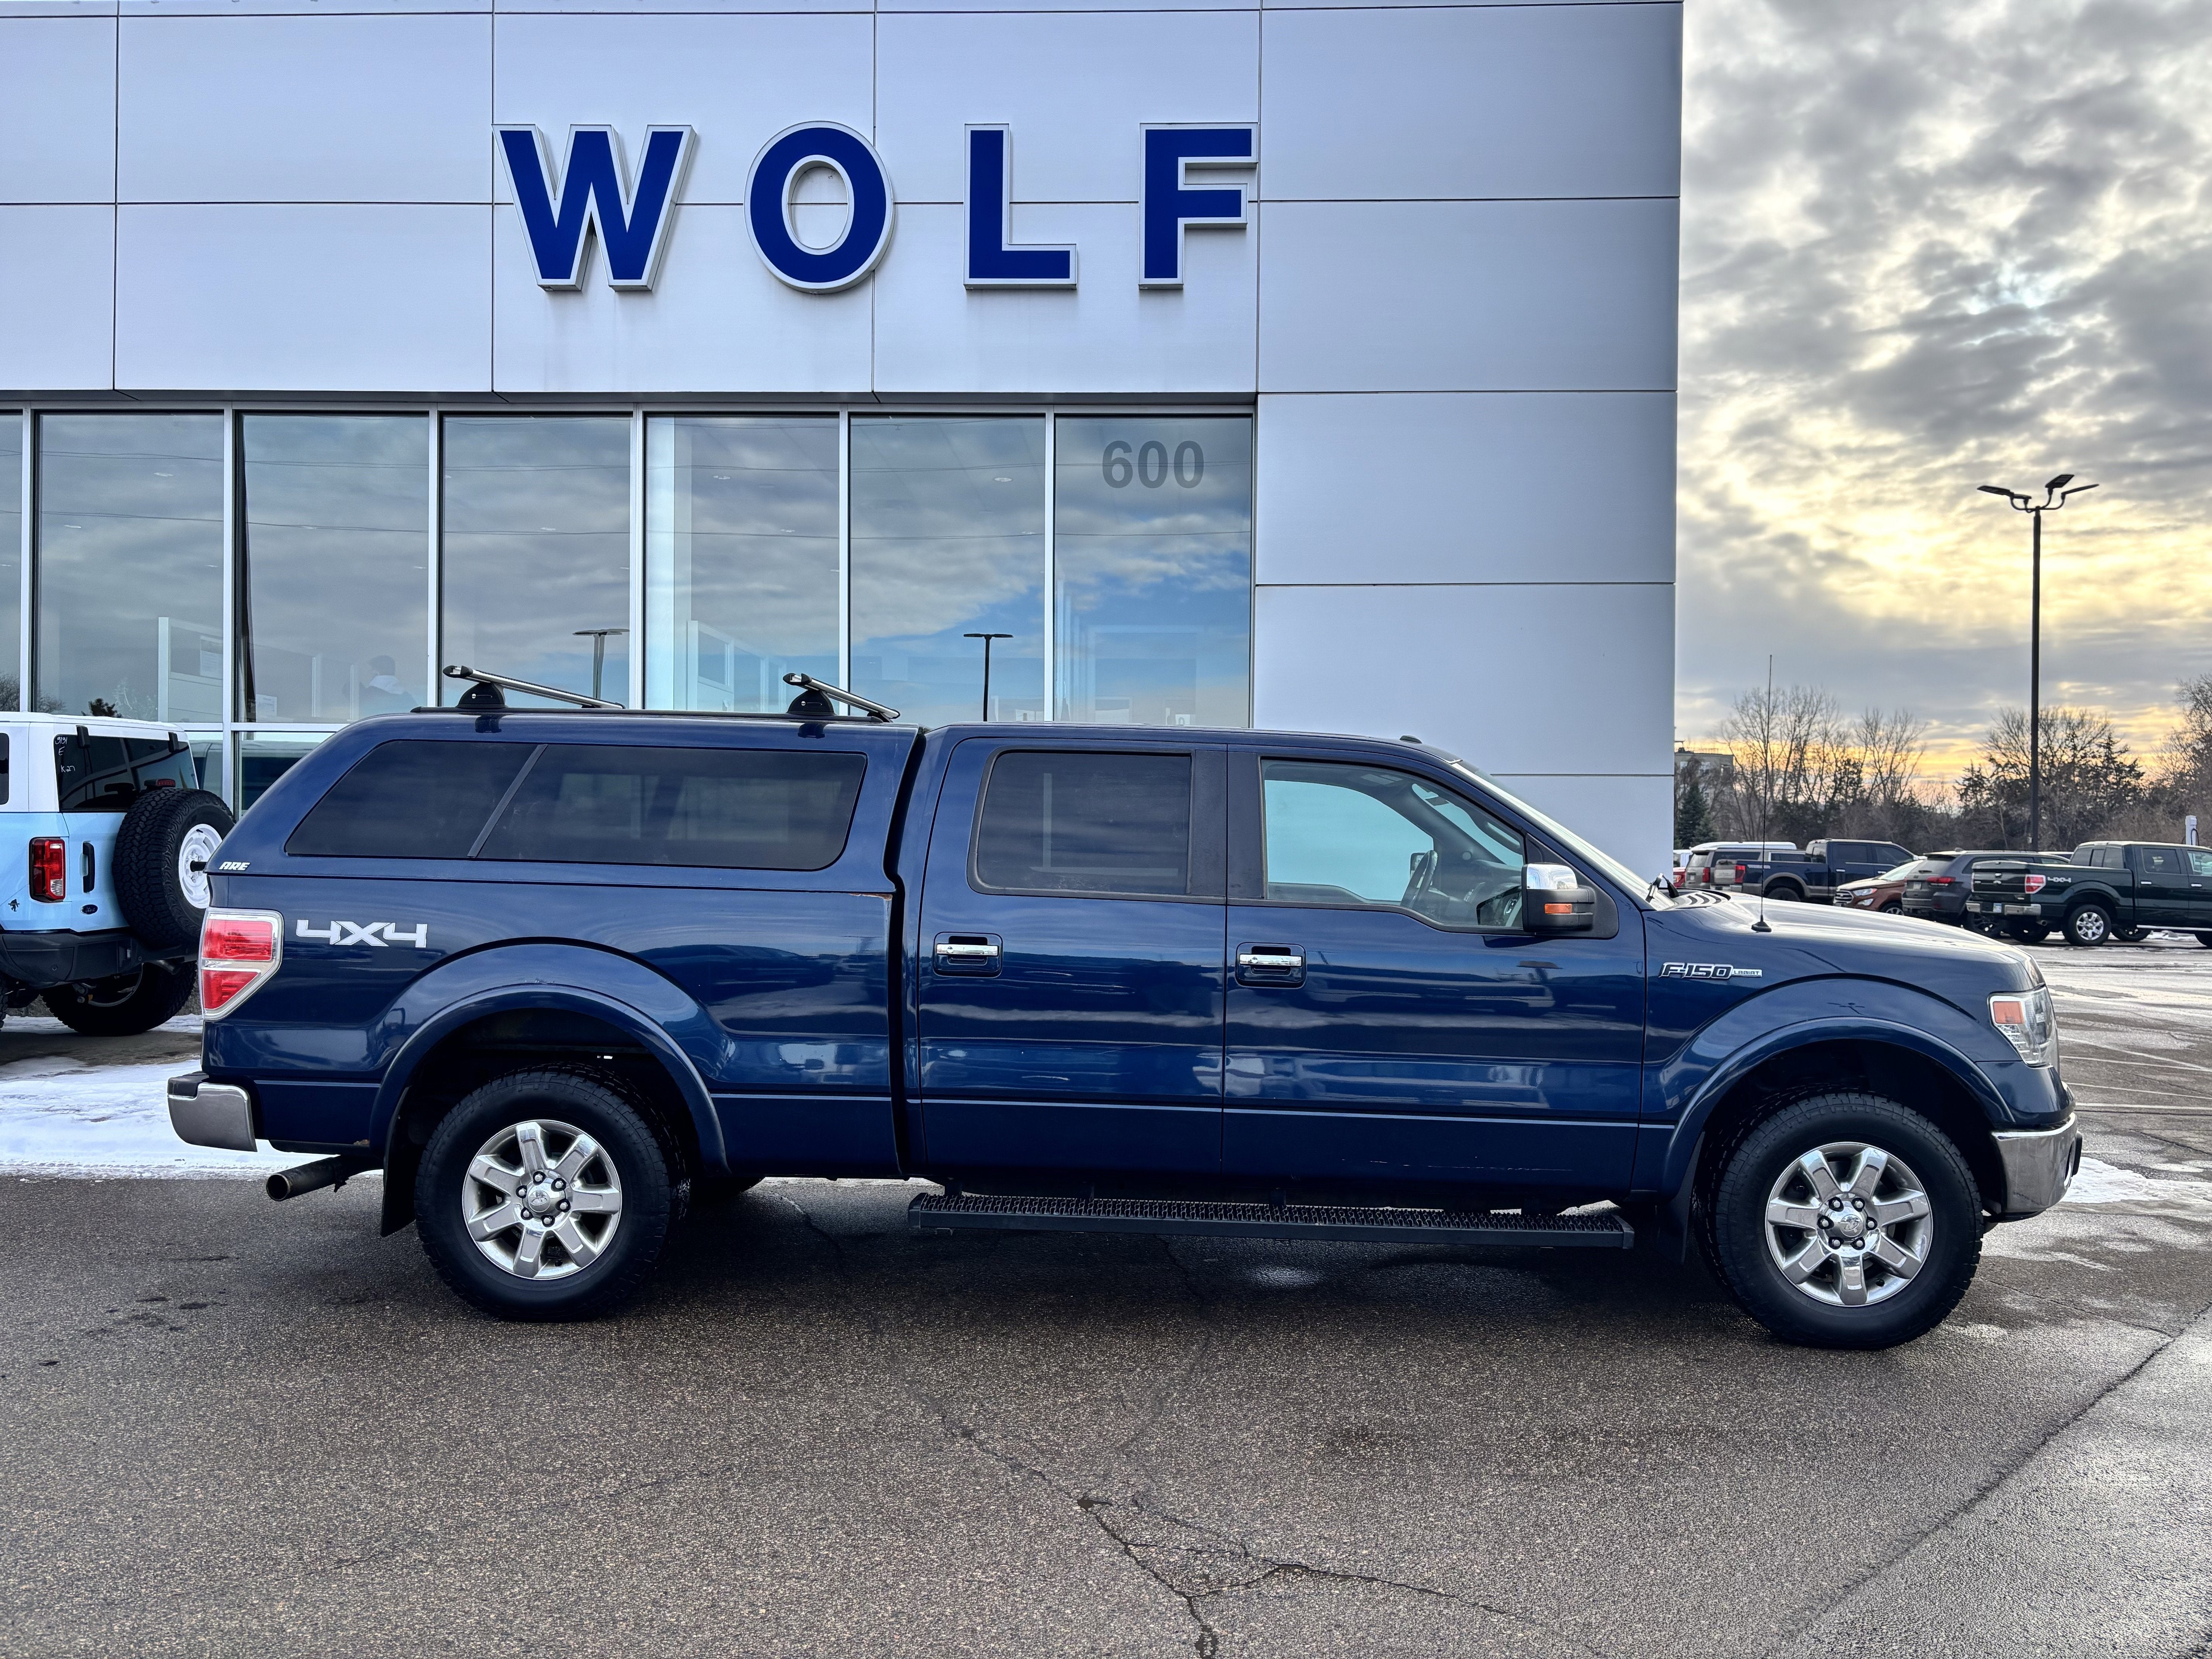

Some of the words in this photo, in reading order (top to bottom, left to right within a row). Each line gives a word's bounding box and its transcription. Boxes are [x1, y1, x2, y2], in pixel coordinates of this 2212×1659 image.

[492, 121, 1258, 293] WOLF
[1103, 441, 1204, 488] 600
[219, 862, 251, 871] ARE
